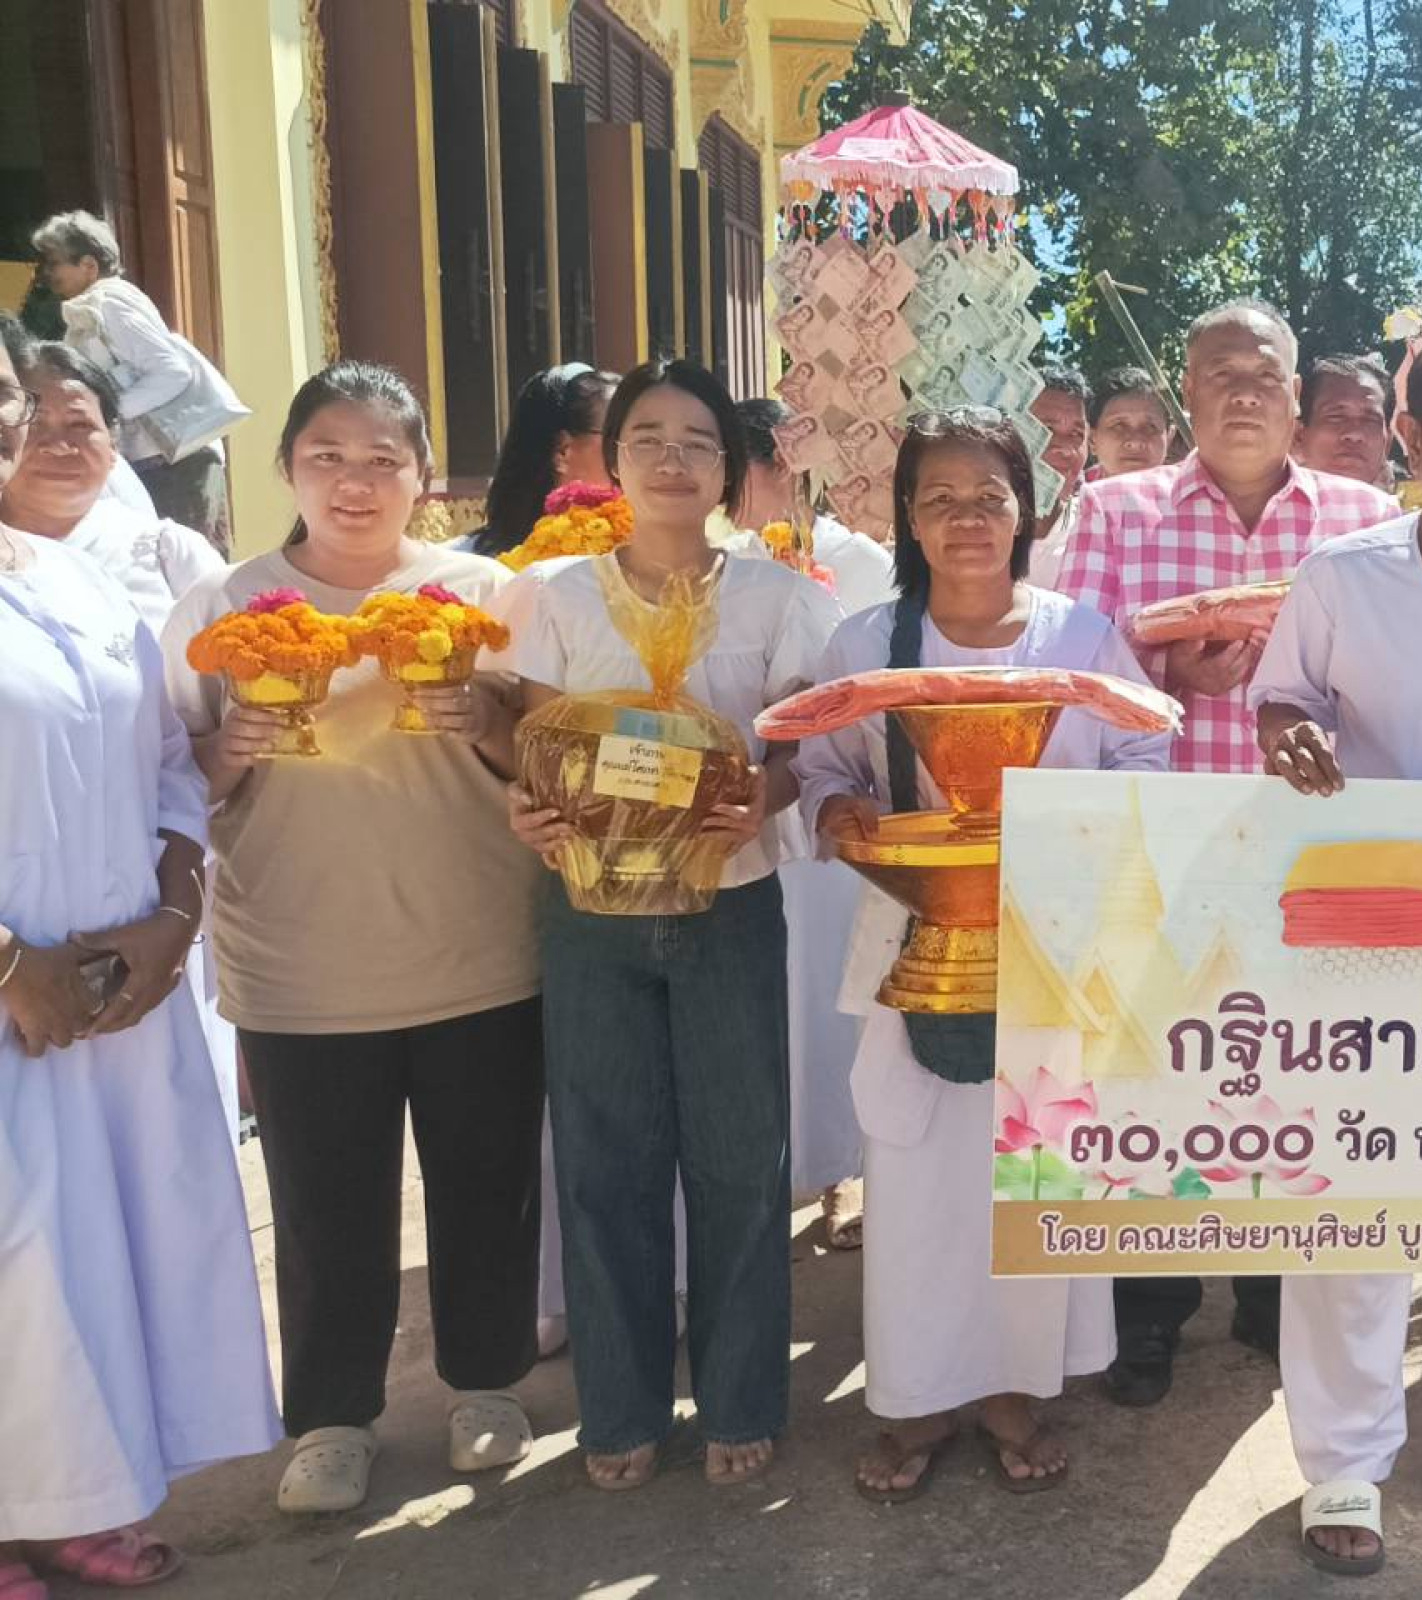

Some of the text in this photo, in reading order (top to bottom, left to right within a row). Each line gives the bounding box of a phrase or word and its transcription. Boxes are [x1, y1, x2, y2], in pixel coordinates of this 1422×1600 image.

[1070, 1123, 1314, 1171] ๓๐,๐๐๐
[1335, 1109, 1396, 1161] วัด
[1040, 1213, 1106, 1252] โดย
[1118, 1209, 1387, 1261] คณะศิษยานุศิษย์
